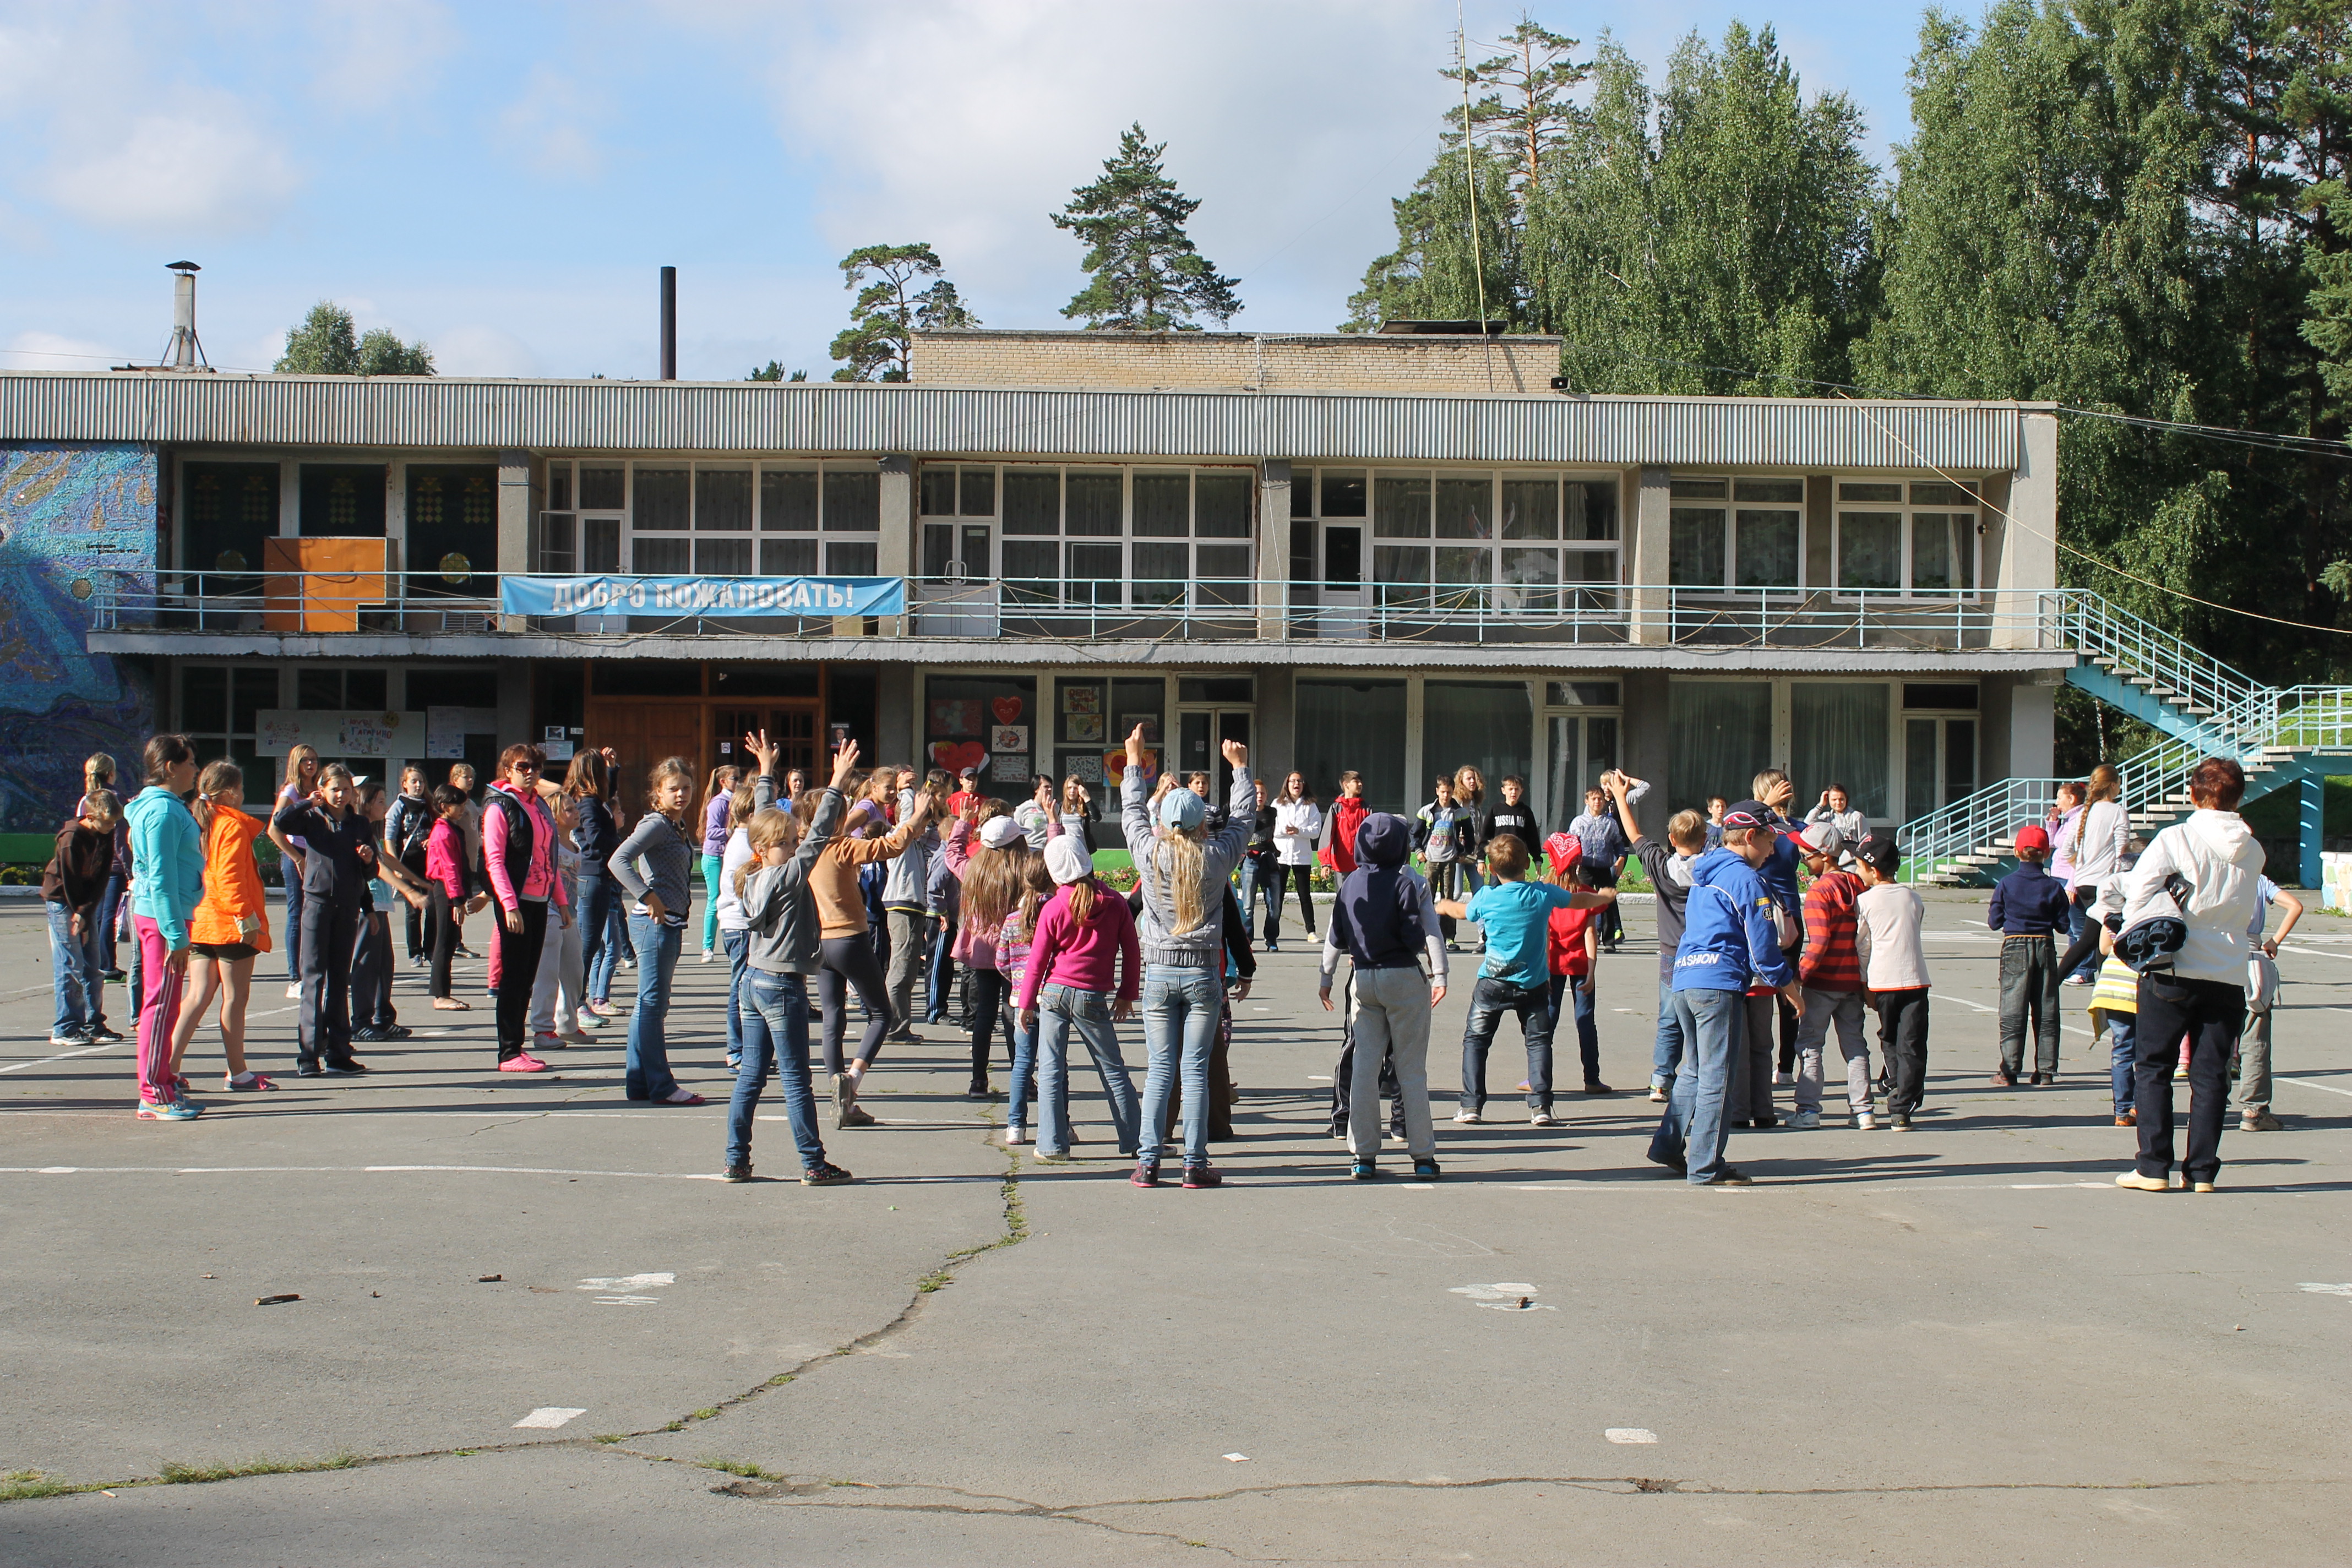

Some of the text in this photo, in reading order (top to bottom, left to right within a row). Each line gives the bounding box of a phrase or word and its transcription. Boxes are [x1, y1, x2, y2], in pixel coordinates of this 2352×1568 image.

[553, 583, 853, 612] ДОБРО ПОЖАЛОВАТЬ!
[1494, 815, 1515, 827] RUSSIA
[1863, 852, 1875, 863] 23
[1677, 953, 1719, 967] FASHION
